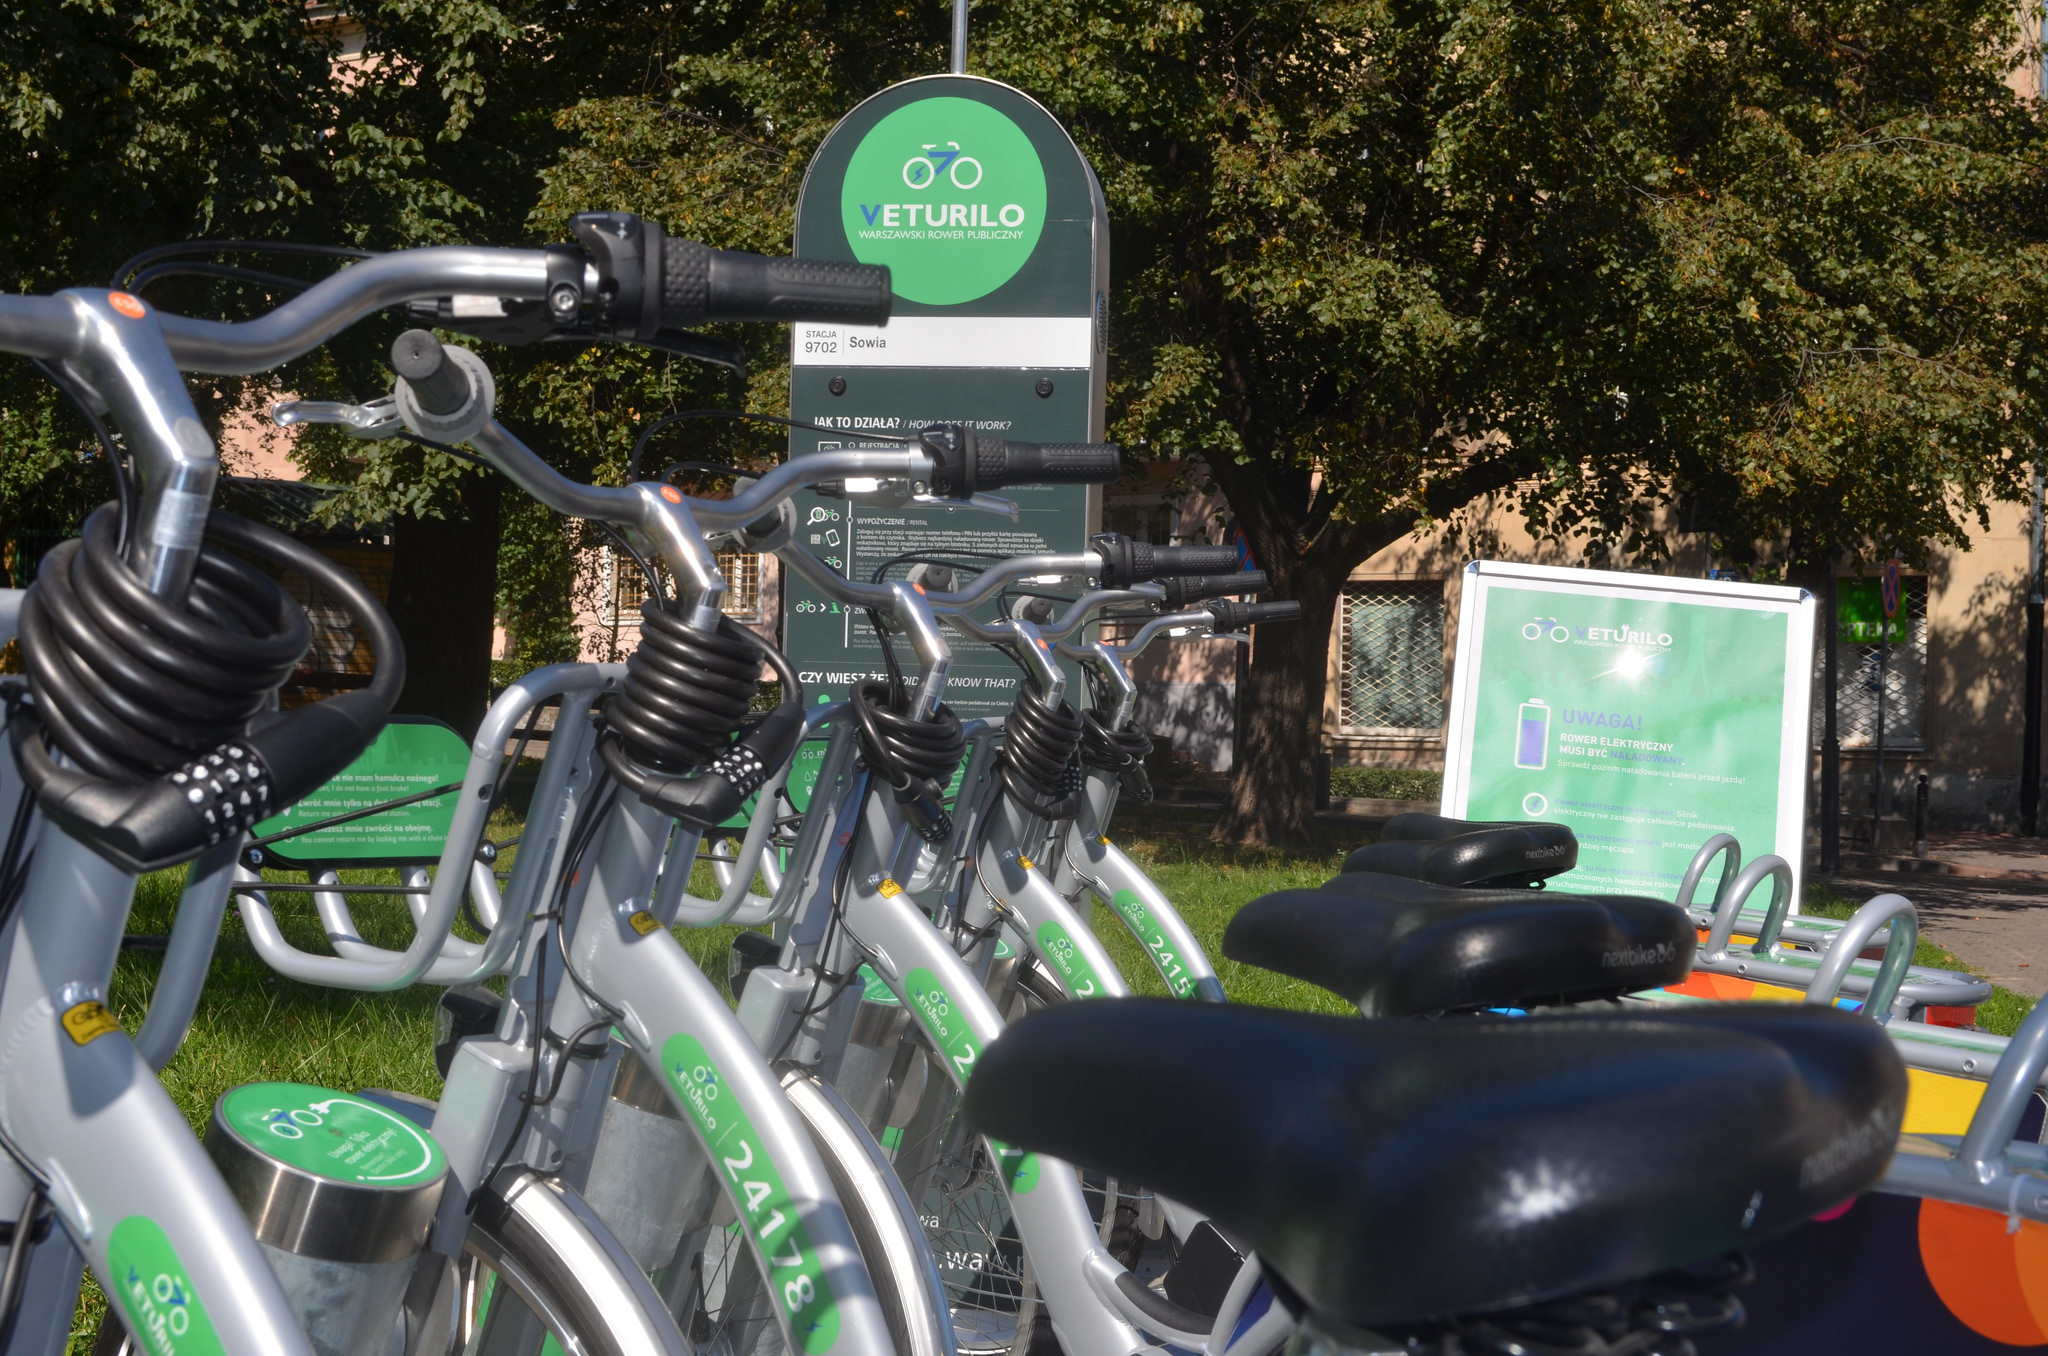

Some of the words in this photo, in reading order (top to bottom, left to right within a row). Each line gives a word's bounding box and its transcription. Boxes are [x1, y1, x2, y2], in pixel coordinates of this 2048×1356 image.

[860, 204, 1025, 227] VETURILO
[859, 230, 925, 240] WARSZAWSKI
[928, 230, 964, 240] ROWER
[967, 230, 1023, 240] PUBLICZNY
[805, 330, 837, 338] STACJA
[850, 336, 886, 349] Sowia
[805, 342, 837, 354] 9702
[836, 416, 852, 428] TO
[854, 416, 900, 428] DZIAŁA?
[908, 420, 934, 428] HOW
[976, 421, 1011, 430] WORK?
[1576, 624, 1672, 646] VETURILO
[799, 672, 823, 683] CZY
[948, 677, 982, 687] KNOW
[984, 678, 1016, 688] THAT?
[1563, 709, 1642, 731] UWAGA!
[1560, 733, 1598, 745] ROWER
[1600, 736, 1674, 752] ELEKTRYCZNY
[1560, 745, 1584, 756] MUSI
[1588, 746, 1608, 758] BYĆ
[1610, 750, 1686, 766] NAŁADOWANY.
[1558, 760, 1590, 770] Sprawdź
[1592, 763, 1620, 772] poziom
[1622, 766, 1670, 778] naładowania
[1672, 770, 1696, 780] baterii
[1698, 773, 1720, 783] przed
[1722, 775, 1746, 785] jazdą!
[1554, 808, 1595, 818] elektryczny
[1597, 812, 1608, 820] nie
[1610, 814, 1646, 824] zastępuje
[1647, 816, 1686, 827] całkowicie
[1677, 810, 1698, 819] Silnik
[1578, 844, 1599, 852] rdziej
[1662, 841, 1676, 849] jest
[1606, 886, 1622, 896] przy
[1614, 877, 1652, 888] hamulców
[1654, 880, 1682, 890] rolkow
[1122, 903, 1144, 932] VETURILO
[1046, 936, 1072, 974] VETURILO
[1150, 935, 1190, 994] 2415
[1602, 943, 1656, 968] nextbike
[916, 988, 948, 1037] VETURILO
[676, 1062, 716, 1130] VETURILO
[724, 1140, 815, 1312] 24178
